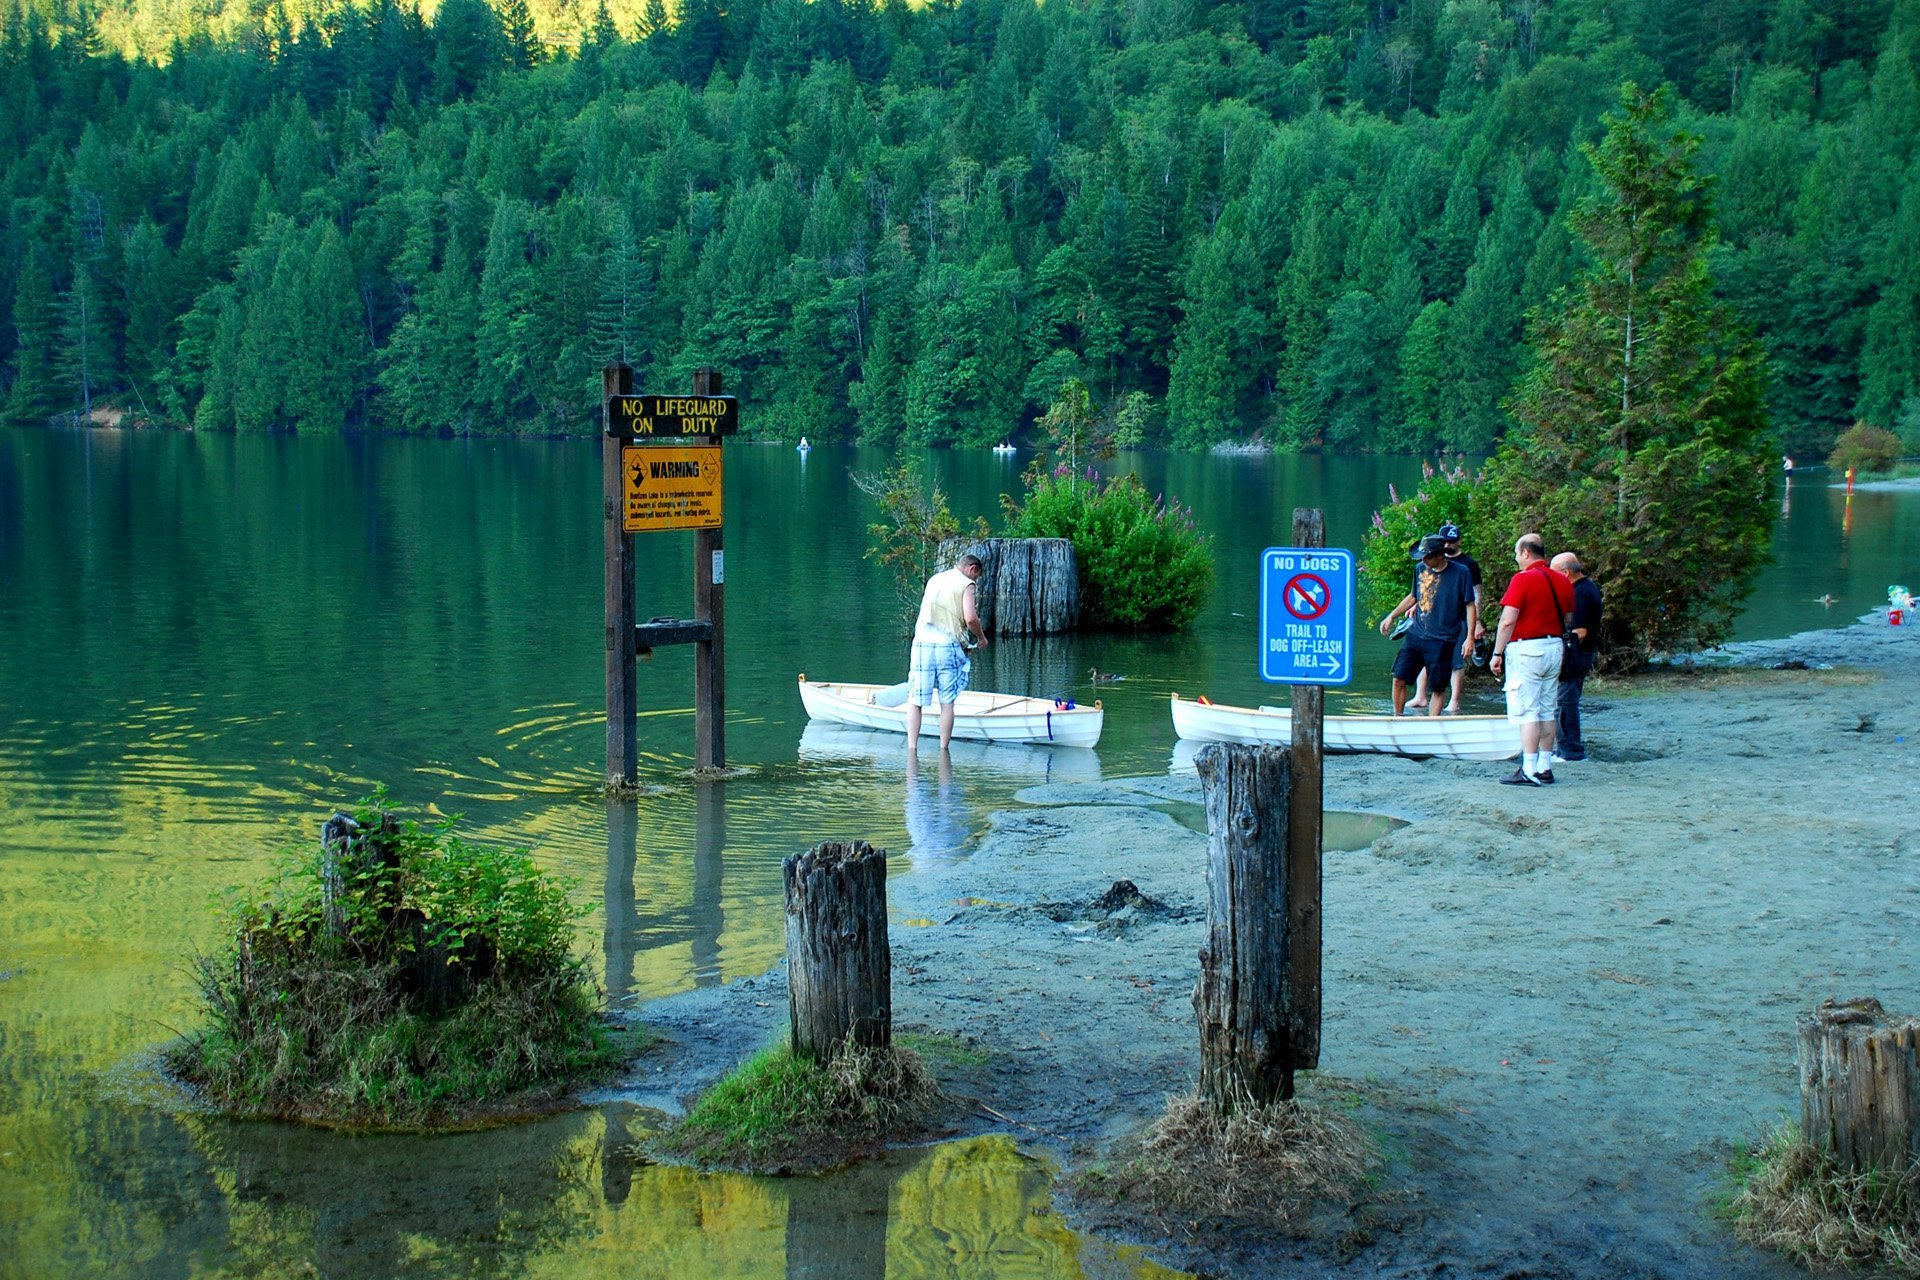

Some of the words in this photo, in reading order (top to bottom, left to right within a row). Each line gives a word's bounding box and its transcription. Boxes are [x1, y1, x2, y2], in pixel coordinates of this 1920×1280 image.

[622, 400, 643, 416] NO
[656, 400, 727, 416] LIFEGUARD
[633, 418, 652, 433] ON
[683, 418, 717, 433] DUTY
[650, 461, 699, 479] WARNING
[1274, 557, 1294, 570] NO
[1300, 558, 1340, 571] DOGS
[1285, 624, 1311, 638] TRAIL
[1315, 625, 1327, 638] TO
[1270, 639, 1288, 652] DOG
[1292, 639, 1342, 653] OFF-LEASH
[1294, 654, 1318, 667] AREA
